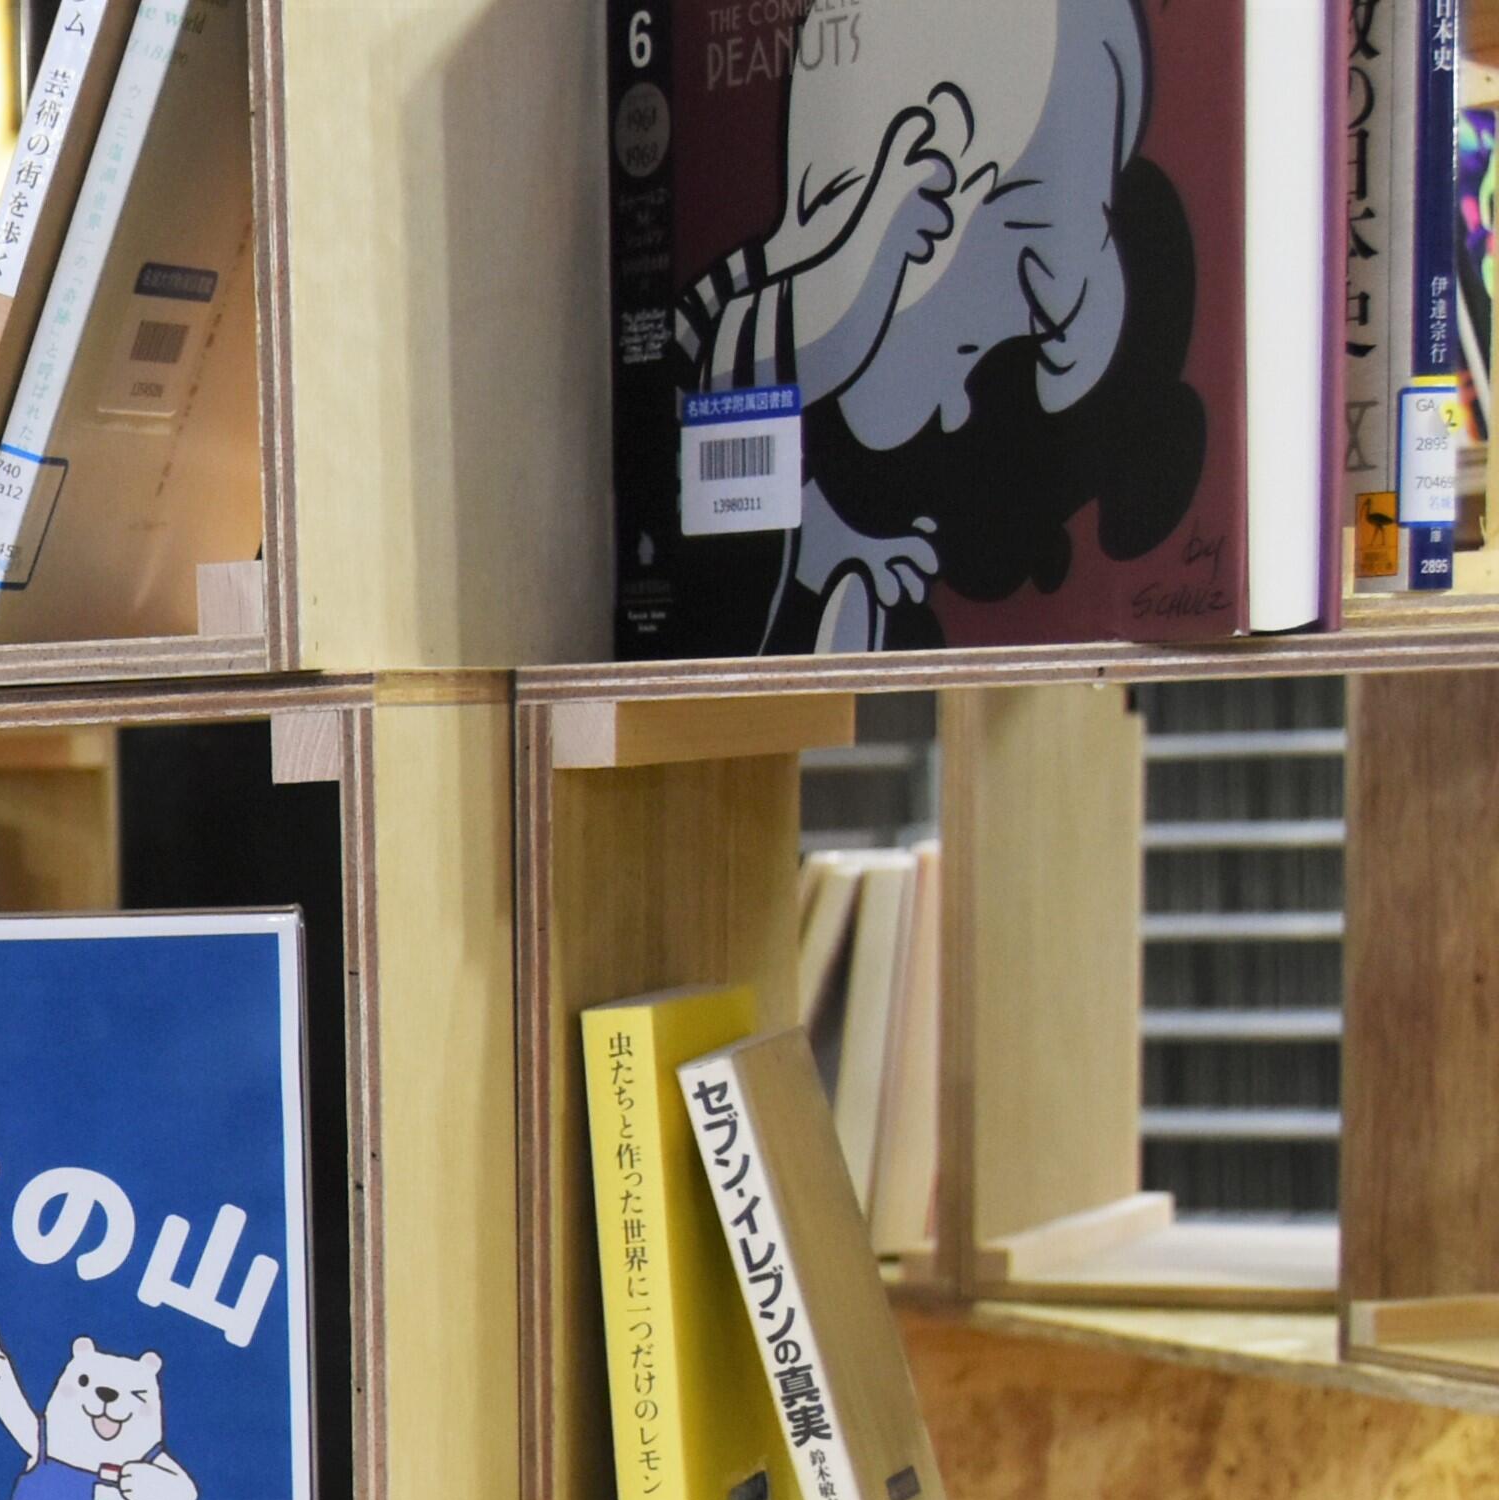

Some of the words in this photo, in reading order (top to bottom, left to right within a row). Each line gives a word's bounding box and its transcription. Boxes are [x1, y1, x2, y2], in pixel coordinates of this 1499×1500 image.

[628, 9, 653, 69] 6
[709, 8, 740, 33] THE
[706, 13, 861, 91] PEANUTS
[1429, 275, 1450, 364] 伊達宗行
[687, 389, 795, 417] 名城大学附属図書館
[712, 497, 763, 514] 13980311
[1420, 559, 1450, 574] 2895
[607, 1031, 664, 1495] 虫たちと作った世界に一つだけのレモン
